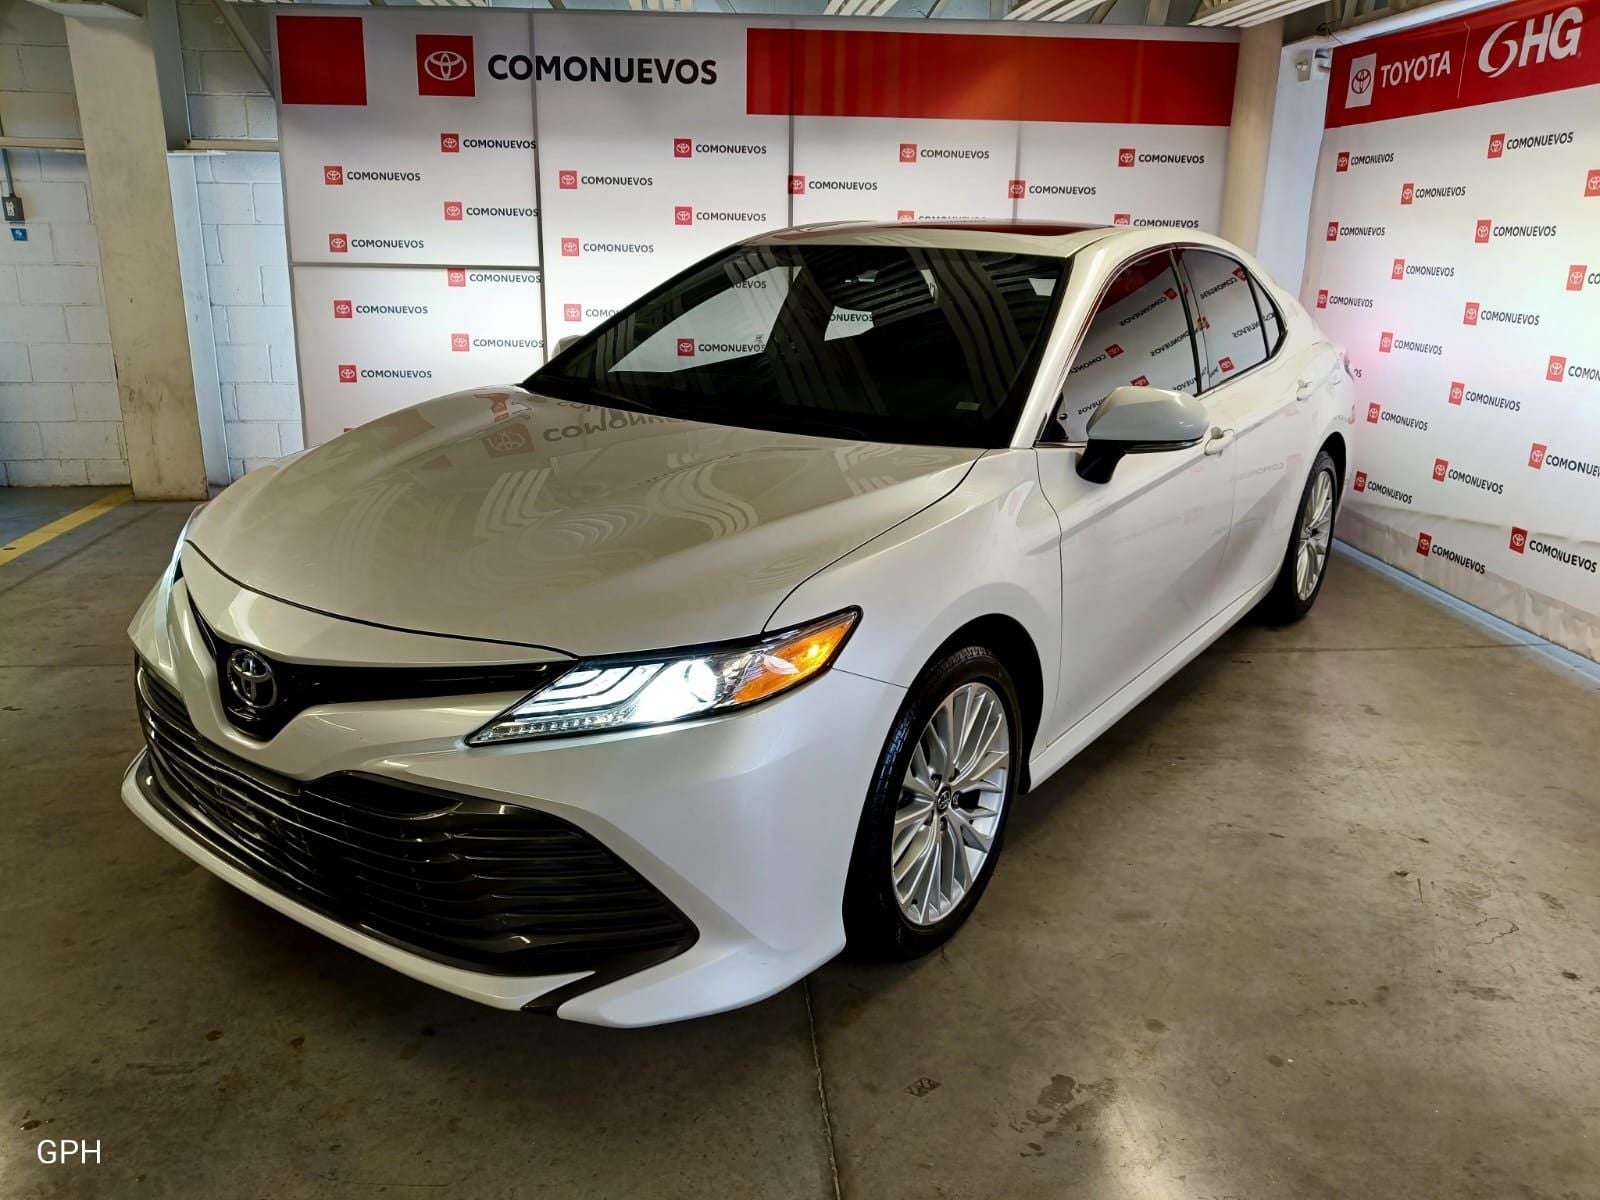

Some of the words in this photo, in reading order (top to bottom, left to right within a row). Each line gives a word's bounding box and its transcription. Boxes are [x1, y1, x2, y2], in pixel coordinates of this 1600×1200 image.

[487, 54, 717, 85] COMONUEVOS
[1380, 50, 1451, 89] TOYOTA
[463, 138, 537, 149] COMONUEVOS
[1506, 131, 1574, 150] COMONUEVOS
[695, 144, 767, 155] COMONUEVOS
[920, 149, 990, 160] COMONUEVOS
[1138, 154, 1205, 165] COMONUEVOS
[1351, 152, 1394, 166] COMONUEVOS
[346, 171, 421, 182] COMONUEVOS
[581, 175, 653, 186] COMONUEVOS
[808, 181, 878, 191] COMONUEVOS
[1029, 185, 1097, 196] COMONUEVOS
[1415, 186, 1466, 198] COMONUEVOS
[466, 207, 539, 217] COMONUEVOS
[696, 211, 767, 222] COMONUEVOS
[1133, 219, 1199, 229] COMONUEVOS
[1340, 226, 1385, 237] COMONUEVOS
[1493, 225, 1557, 237] COMONUEVOS
[351, 238, 424, 249] COMONUEVOS
[583, 243, 654, 253] COMONUEVOS
[1406, 265, 1455, 277] COMONUEVOS
[469, 273, 541, 284] COMONUEVOS
[1329, 295, 1373, 308] COMONUEVOS
[356, 304, 428, 315] COMONUEVOS
[830, 313, 873, 322] ONUEVOS
[1480, 310, 1540, 326] COMONUEVOS
[473, 338, 544, 348] COMONUEVOS
[1394, 339, 1443, 355] COMONUEVOS
[360, 368, 432, 379] COMONUEVOS
[1465, 391, 1521, 412] COMONUEVOS
[1381, 411, 1428, 431] COMONUEVOS
[1545, 454, 1600, 477] COMONUE
[1448, 469, 1504, 495] COMONUEVOS
[1367, 481, 1413, 504] COMONUEVOS
[1432, 545, 1486, 575] COMONUEVOS
[1529, 540, 1598, 573] COMONUEVOS
